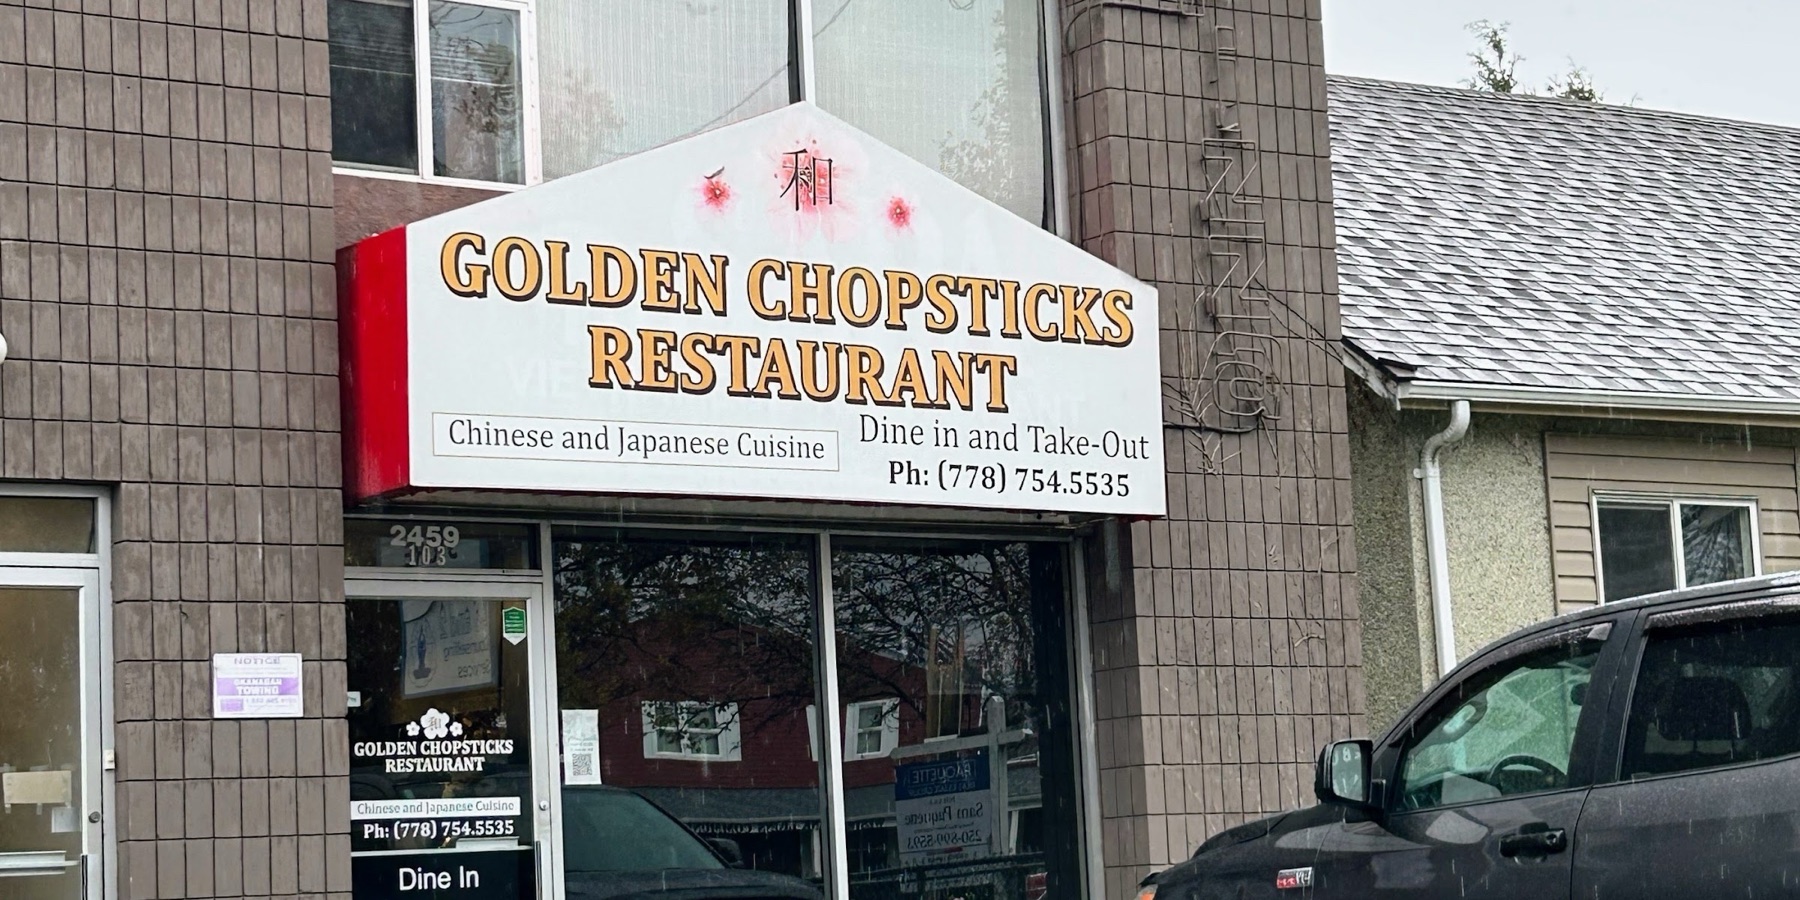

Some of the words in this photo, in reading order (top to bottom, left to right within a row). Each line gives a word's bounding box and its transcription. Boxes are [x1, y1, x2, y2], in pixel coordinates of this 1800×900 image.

[440, 231, 729, 318] GOLDEN
[747, 258, 1134, 347] CHOPSTICKS
[587, 325, 1017, 413] RESTAURANT
[449, 419, 553, 448] Chinese
[562, 426, 609, 450] and
[618, 426, 729, 459] Japanese
[737, 432, 825, 460] Cuisine
[860, 414, 924, 446] Dine
[934, 418, 959, 448] in
[968, 423, 1019, 452] and
[1027, 425, 1150, 460] Take-Out
[889, 460, 929, 486] Ph:
[938, 459, 1006, 494] (778)
[1015, 468, 1130, 497] 754.5535
[390, 524, 460, 548] 2459
[409, 545, 447, 566] 103
[354, 741, 417, 757] GOLDEN
[420, 739, 514, 755] CHOPSTICKS
[385, 756, 486, 773] RESTAURANT
[357, 802, 400, 814] Chinese
[403, 801, 423, 813] and
[426, 801, 473, 815] Japanese
[475, 800, 514, 812] Cuisine
[364, 823, 390, 839] Ph:
[393, 820, 437, 840] (778)
[441, 819, 514, 836] 754.5535
[399, 866, 452, 891] Dine
[459, 865, 480, 889] In
